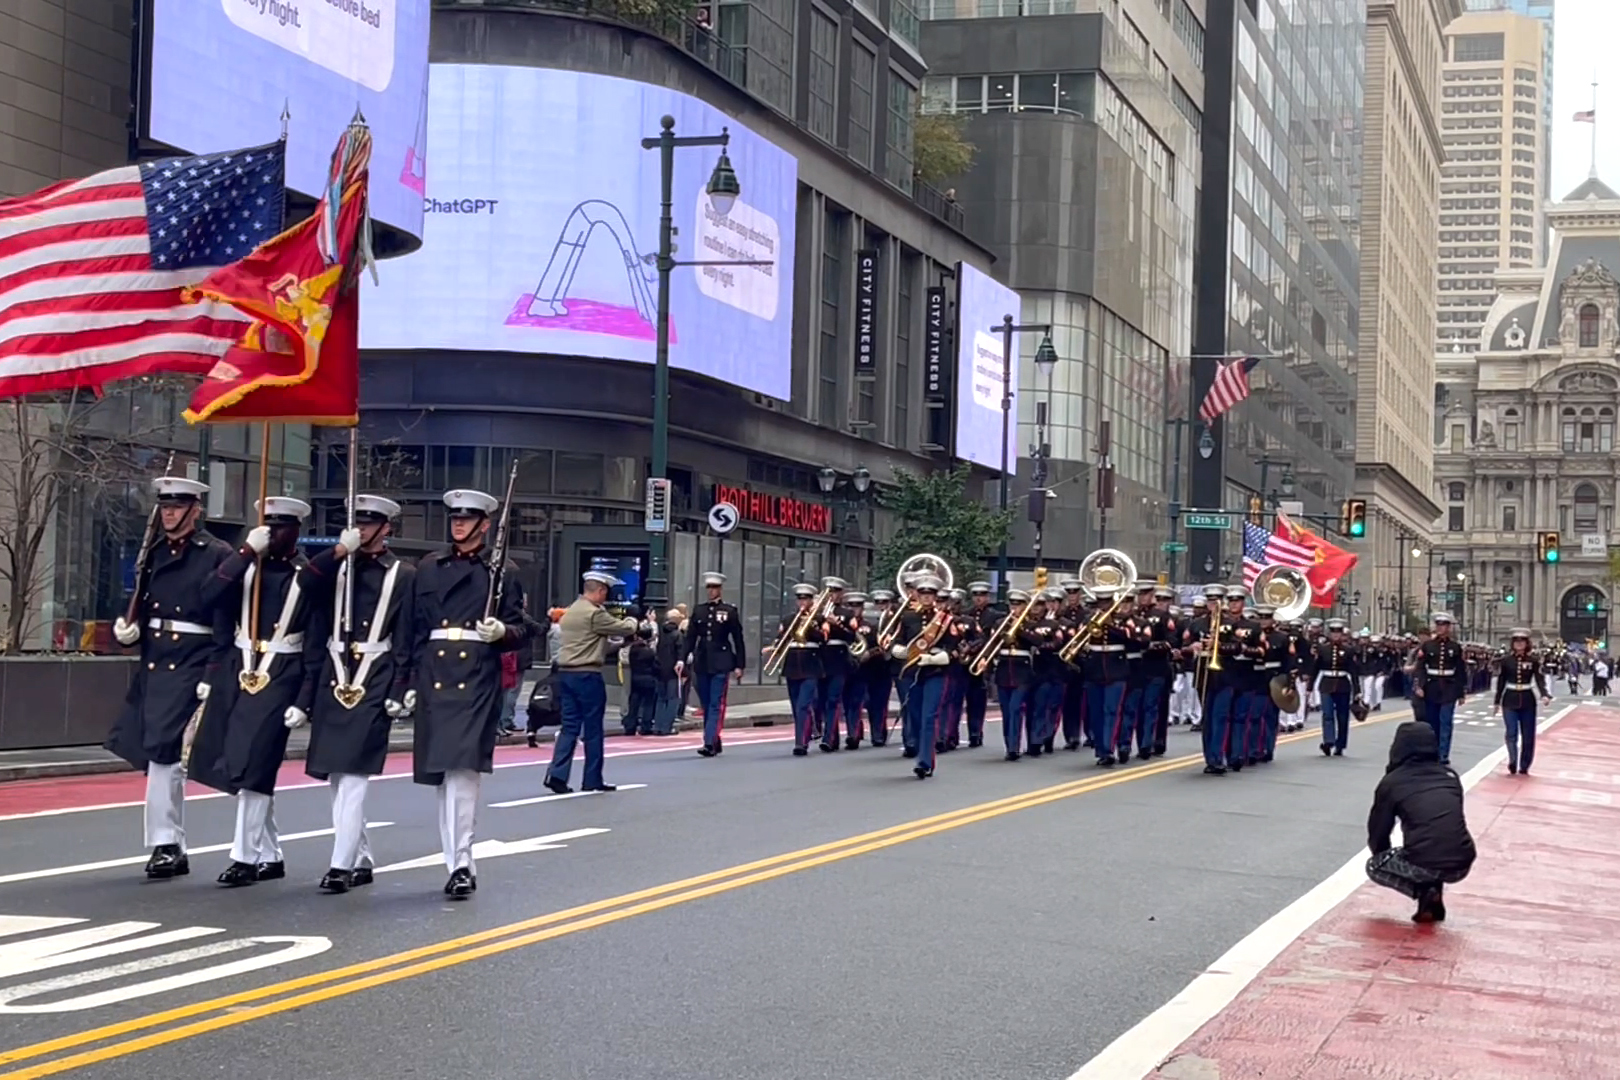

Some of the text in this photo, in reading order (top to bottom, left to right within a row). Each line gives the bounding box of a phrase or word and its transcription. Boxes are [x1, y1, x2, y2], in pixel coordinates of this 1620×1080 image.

[360, 0, 380, 29] bed
[423, 198, 499, 215] ChatGPT
[860, 258, 873, 363] CITY FITNESS
[929, 295, 941, 391] CITY FITNESS
[750, 491, 778, 525] HILL
[780, 496, 831, 534] BREWERY
[1191, 515, 1226, 525] 12th St
[1588, 537, 1601, 545] NO
